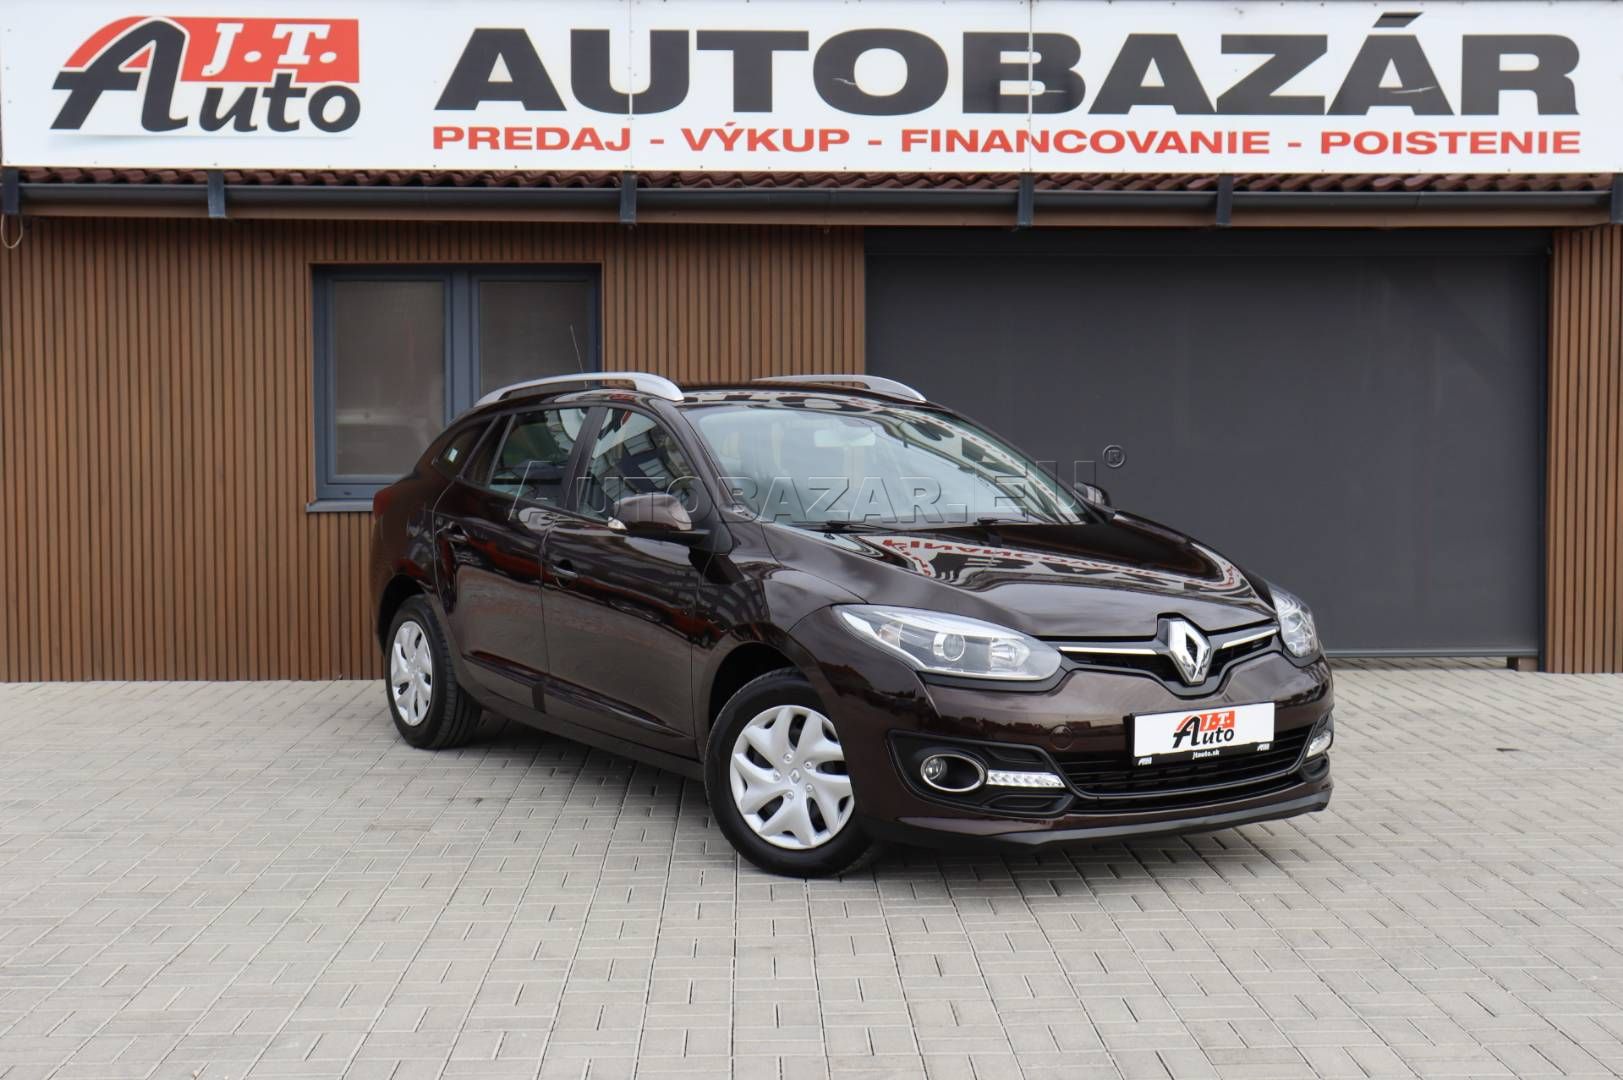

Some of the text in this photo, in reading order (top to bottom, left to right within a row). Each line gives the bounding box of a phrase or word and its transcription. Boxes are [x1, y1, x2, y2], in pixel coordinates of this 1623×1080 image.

[50, 20, 361, 133] Auto
[201, 22, 337, 77] J.T.
[434, 12, 1580, 117] AUTOBAZÁR
[433, 126, 631, 152] PREDAJ
[682, 122, 850, 153] VÝKUP
[901, 128, 1270, 155] FINANCOVANIE
[1320, 130, 1581, 155] POISTENIE
[1172, 716, 1235, 749] Auto
